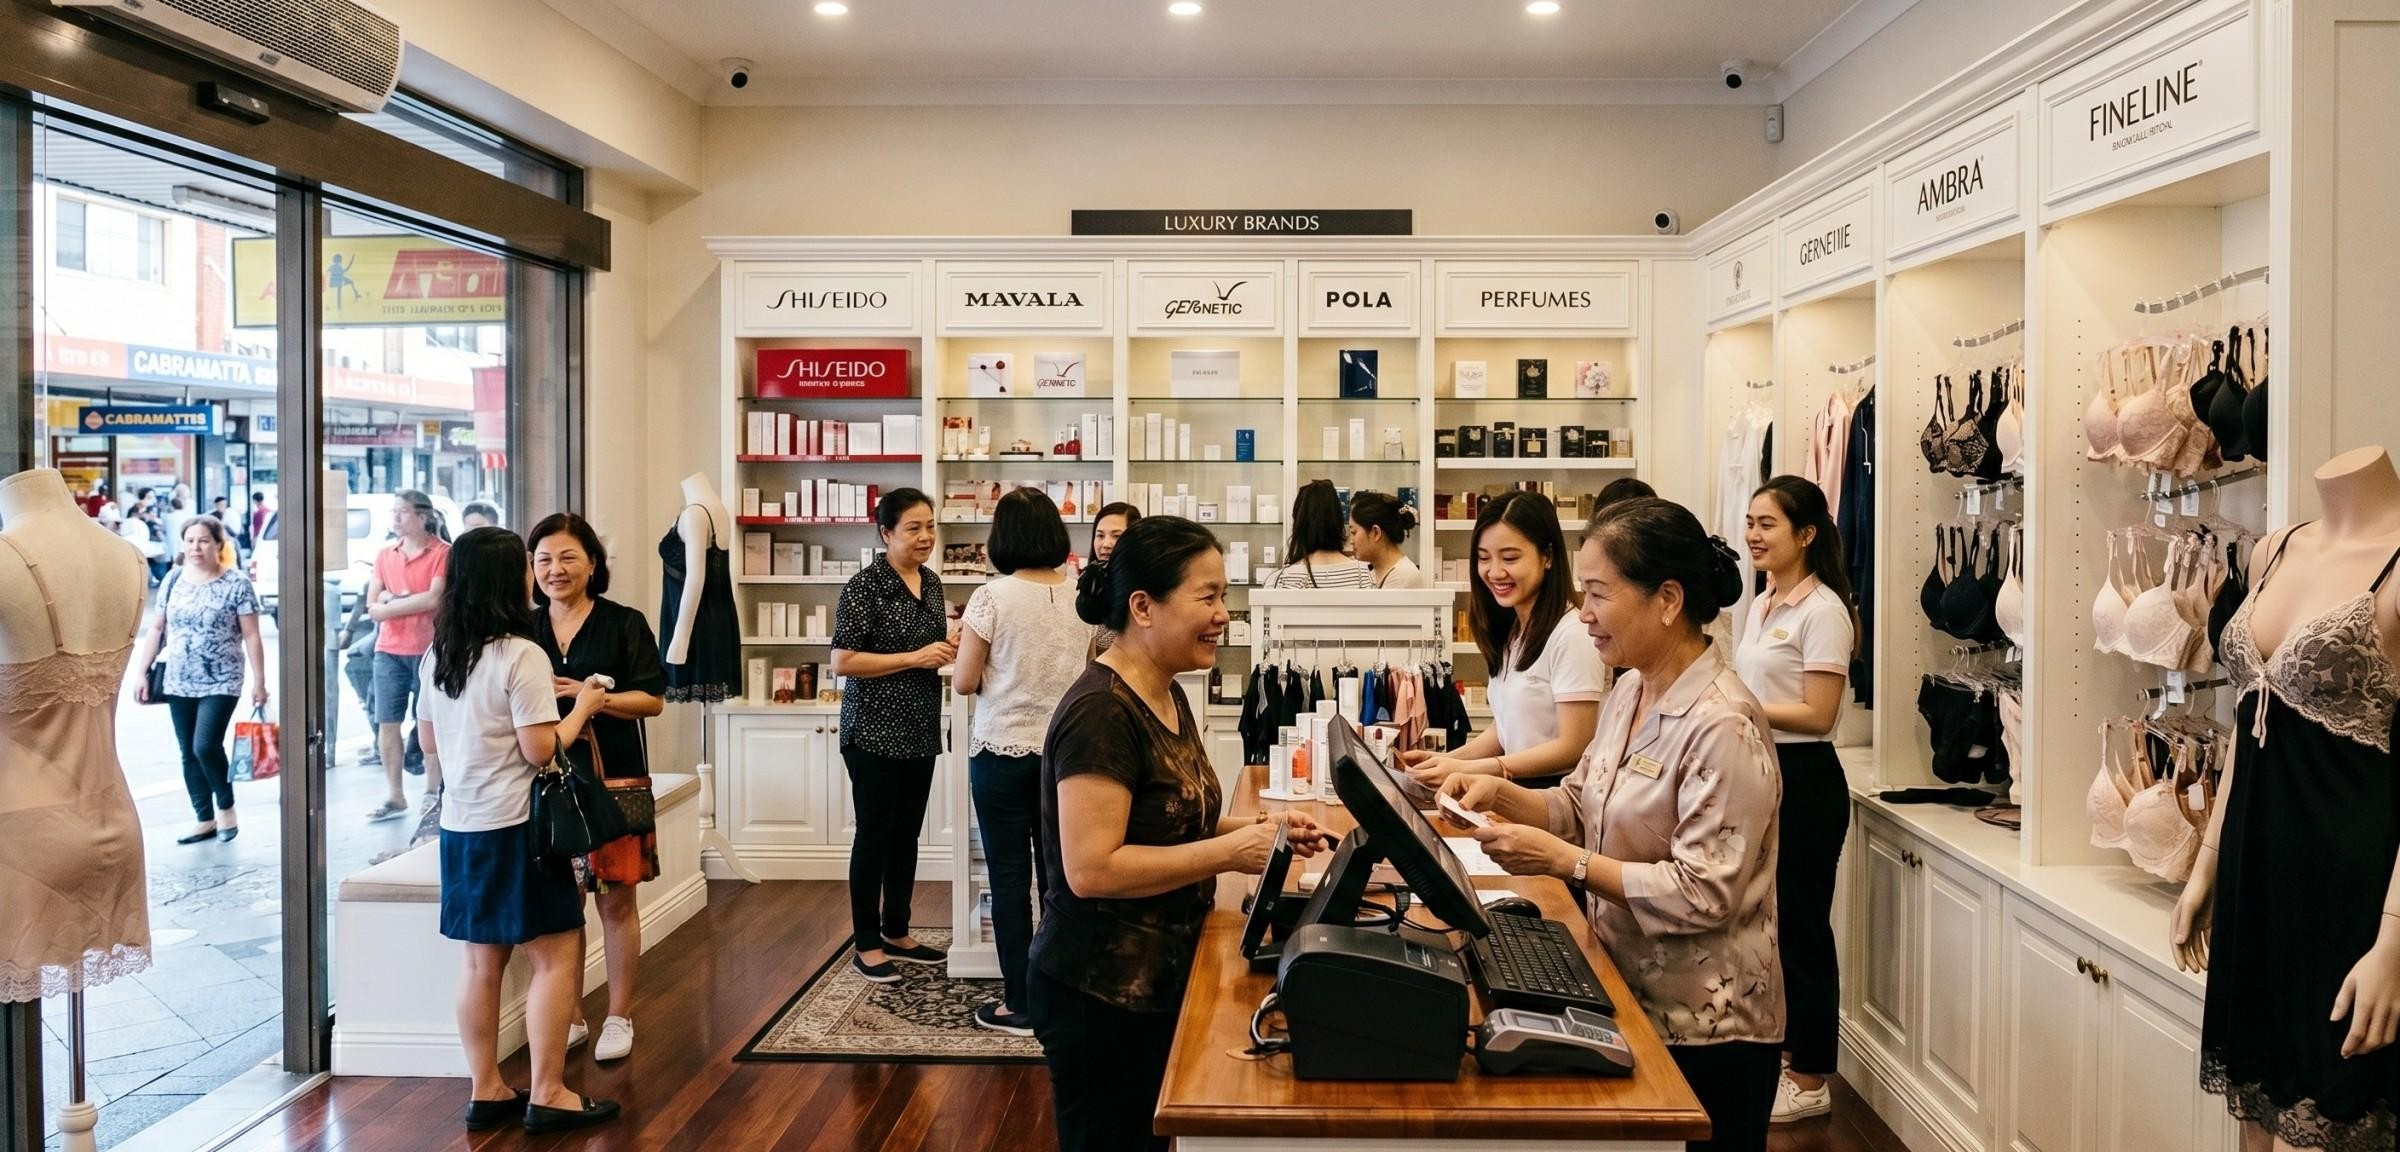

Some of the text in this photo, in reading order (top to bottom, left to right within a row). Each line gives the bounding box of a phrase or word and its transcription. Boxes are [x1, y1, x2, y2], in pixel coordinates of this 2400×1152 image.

[2089, 62, 2198, 142] FINELINE
[1917, 158, 1984, 215] AMBRA
[1165, 215, 1320, 231] LUXURY BRANDS
[767, 289, 887, 310] SHISEIDO
[965, 292, 1084, 307] MAVALA
[1326, 291, 1393, 308] POLA
[1481, 291, 1591, 308] PERFUMES
[134, 350, 252, 385] CABRAMATTA
[776, 359, 886, 379] SHISEIDO
